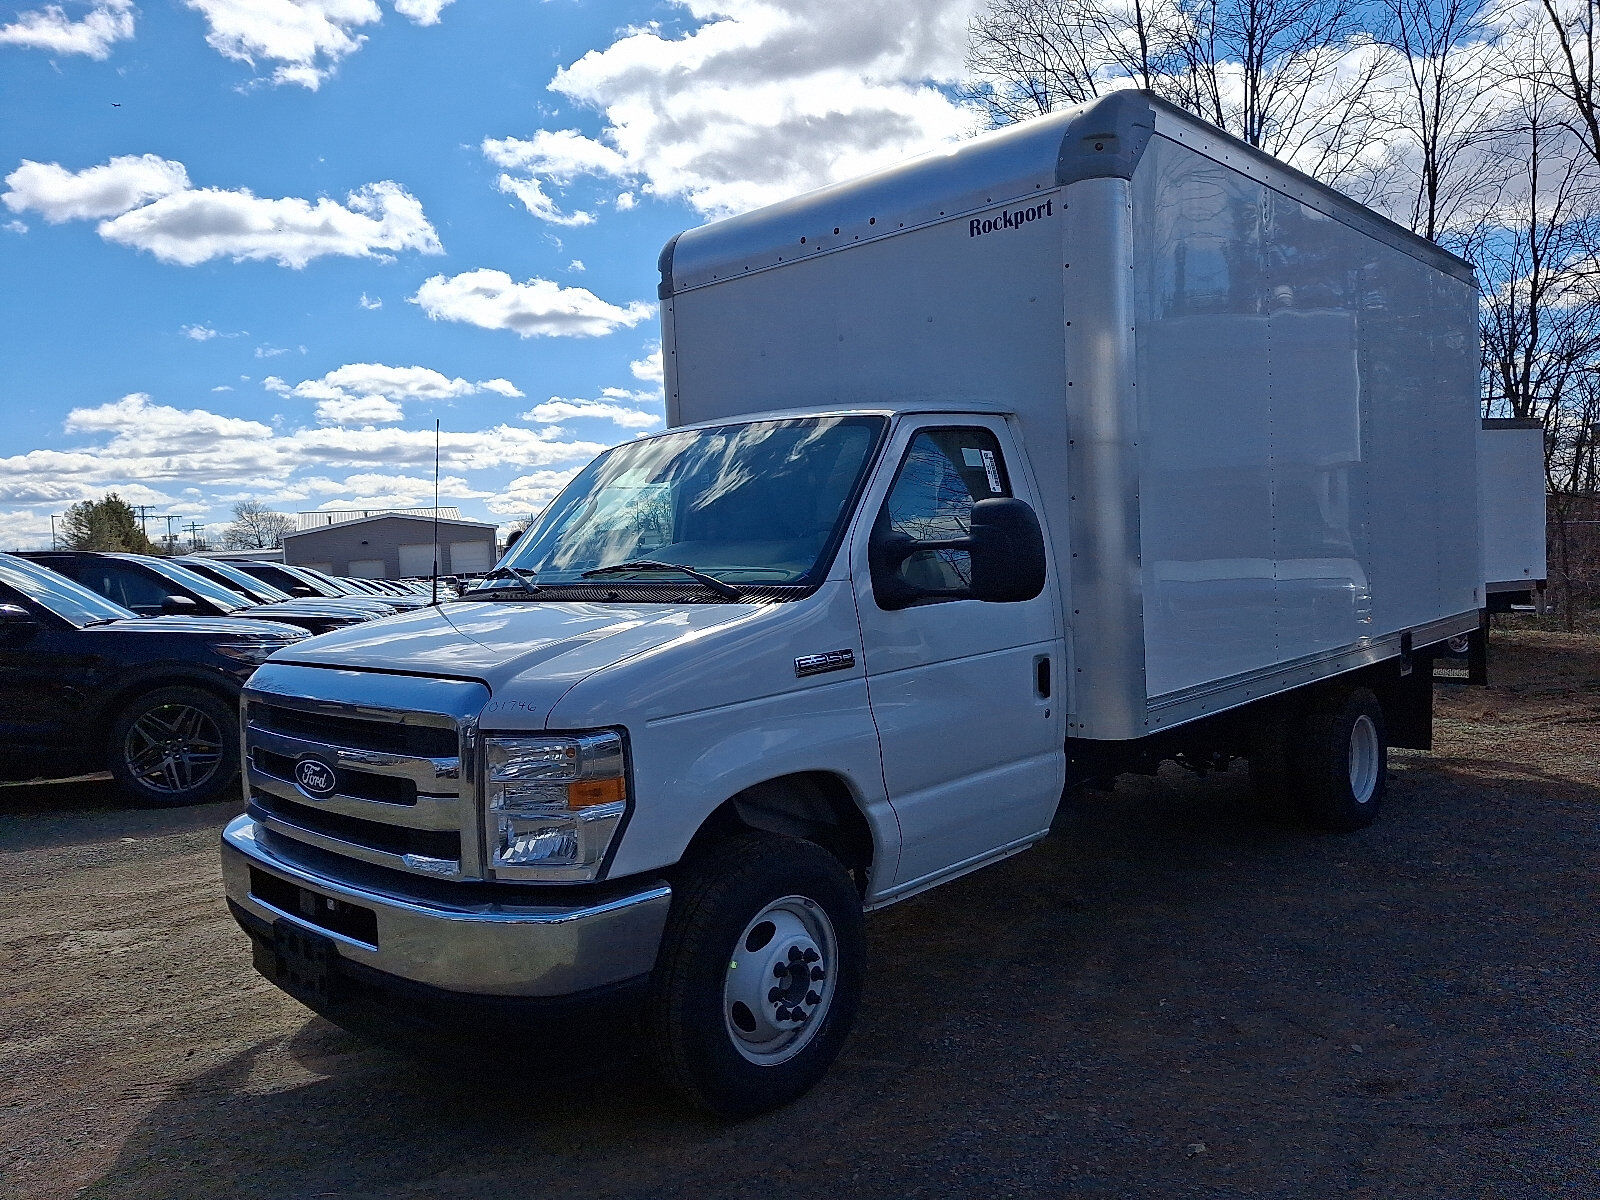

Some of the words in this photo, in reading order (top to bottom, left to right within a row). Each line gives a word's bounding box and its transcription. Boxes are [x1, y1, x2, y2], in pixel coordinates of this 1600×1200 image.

[969, 199, 1053, 237] Rockport
[489, 700, 536, 712] 01746
[302, 763, 327, 788] Ford
